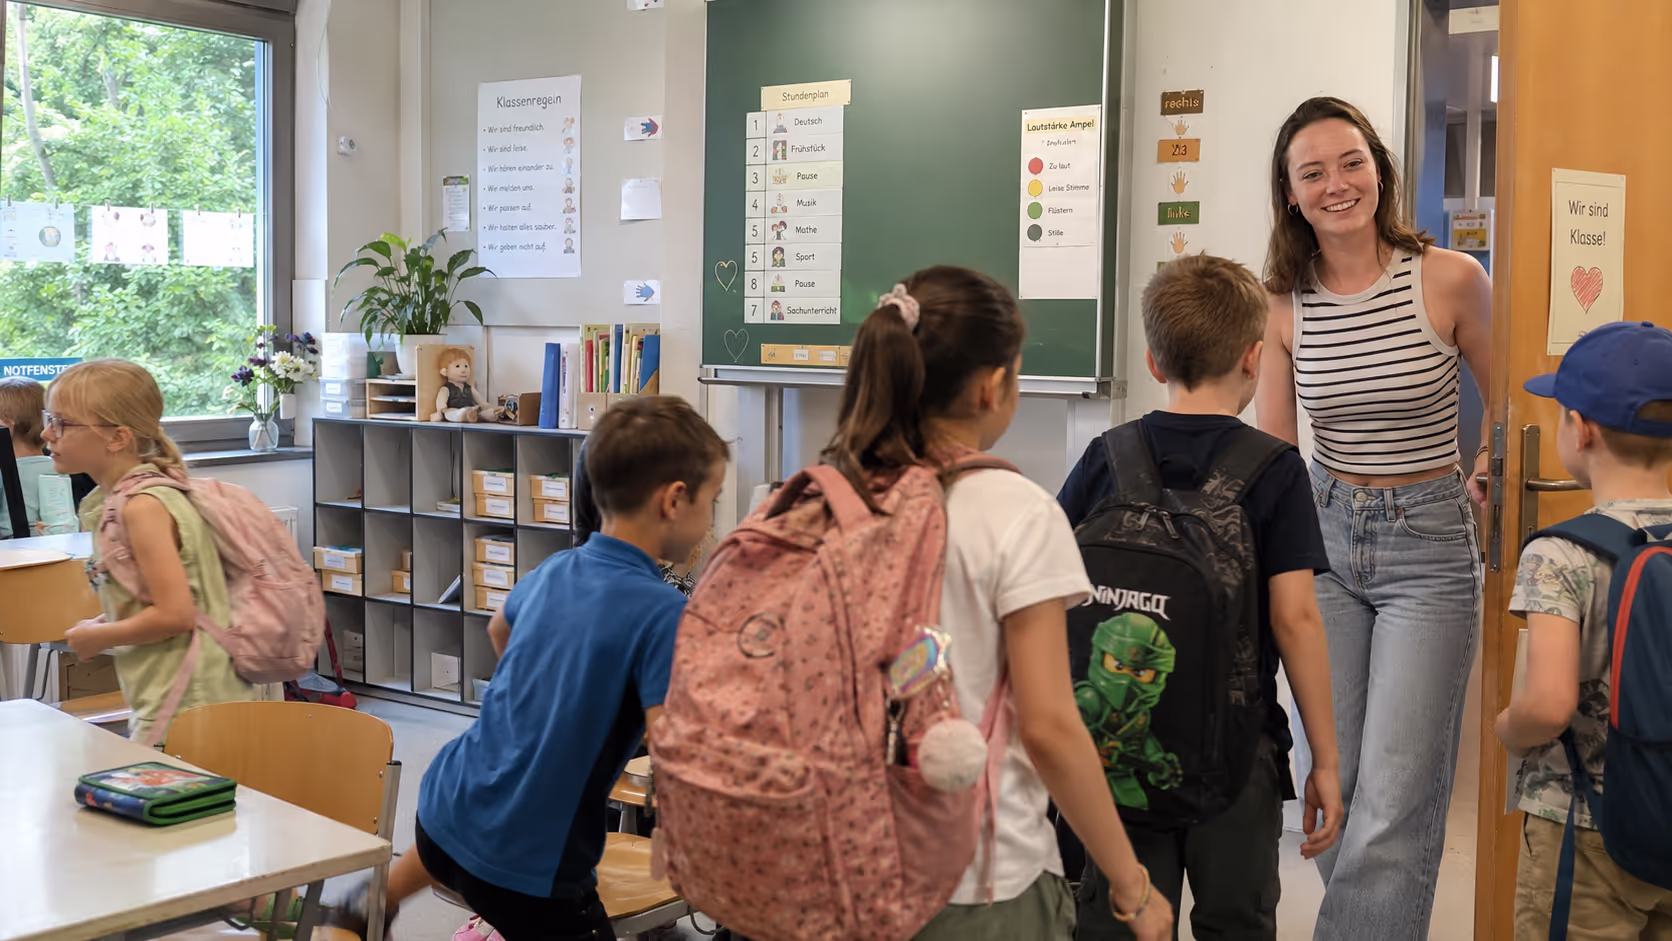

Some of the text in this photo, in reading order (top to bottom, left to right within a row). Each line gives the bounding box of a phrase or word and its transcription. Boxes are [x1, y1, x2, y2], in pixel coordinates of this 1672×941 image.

[782, 90, 829, 102] Stundenplan
[496, 95, 562, 110] Klassenregeln
[754, 117, 823, 131] 1 Deutsch
[1070, 119, 1095, 131] Ampel
[753, 144, 826, 158] 2 Frühstück
[752, 171, 818, 184] 3 Pause
[752, 199, 817, 210] 4 Musik
[1569, 200, 1608, 217] Wir sind
[752, 225, 817, 237] 5 Mathe
[1570, 229, 1606, 246] Klasse!
[751, 251, 815, 263] 5 Sport
[751, 278, 815, 290] 8 Pause
[751, 304, 837, 316] 7 Sachunterricht
